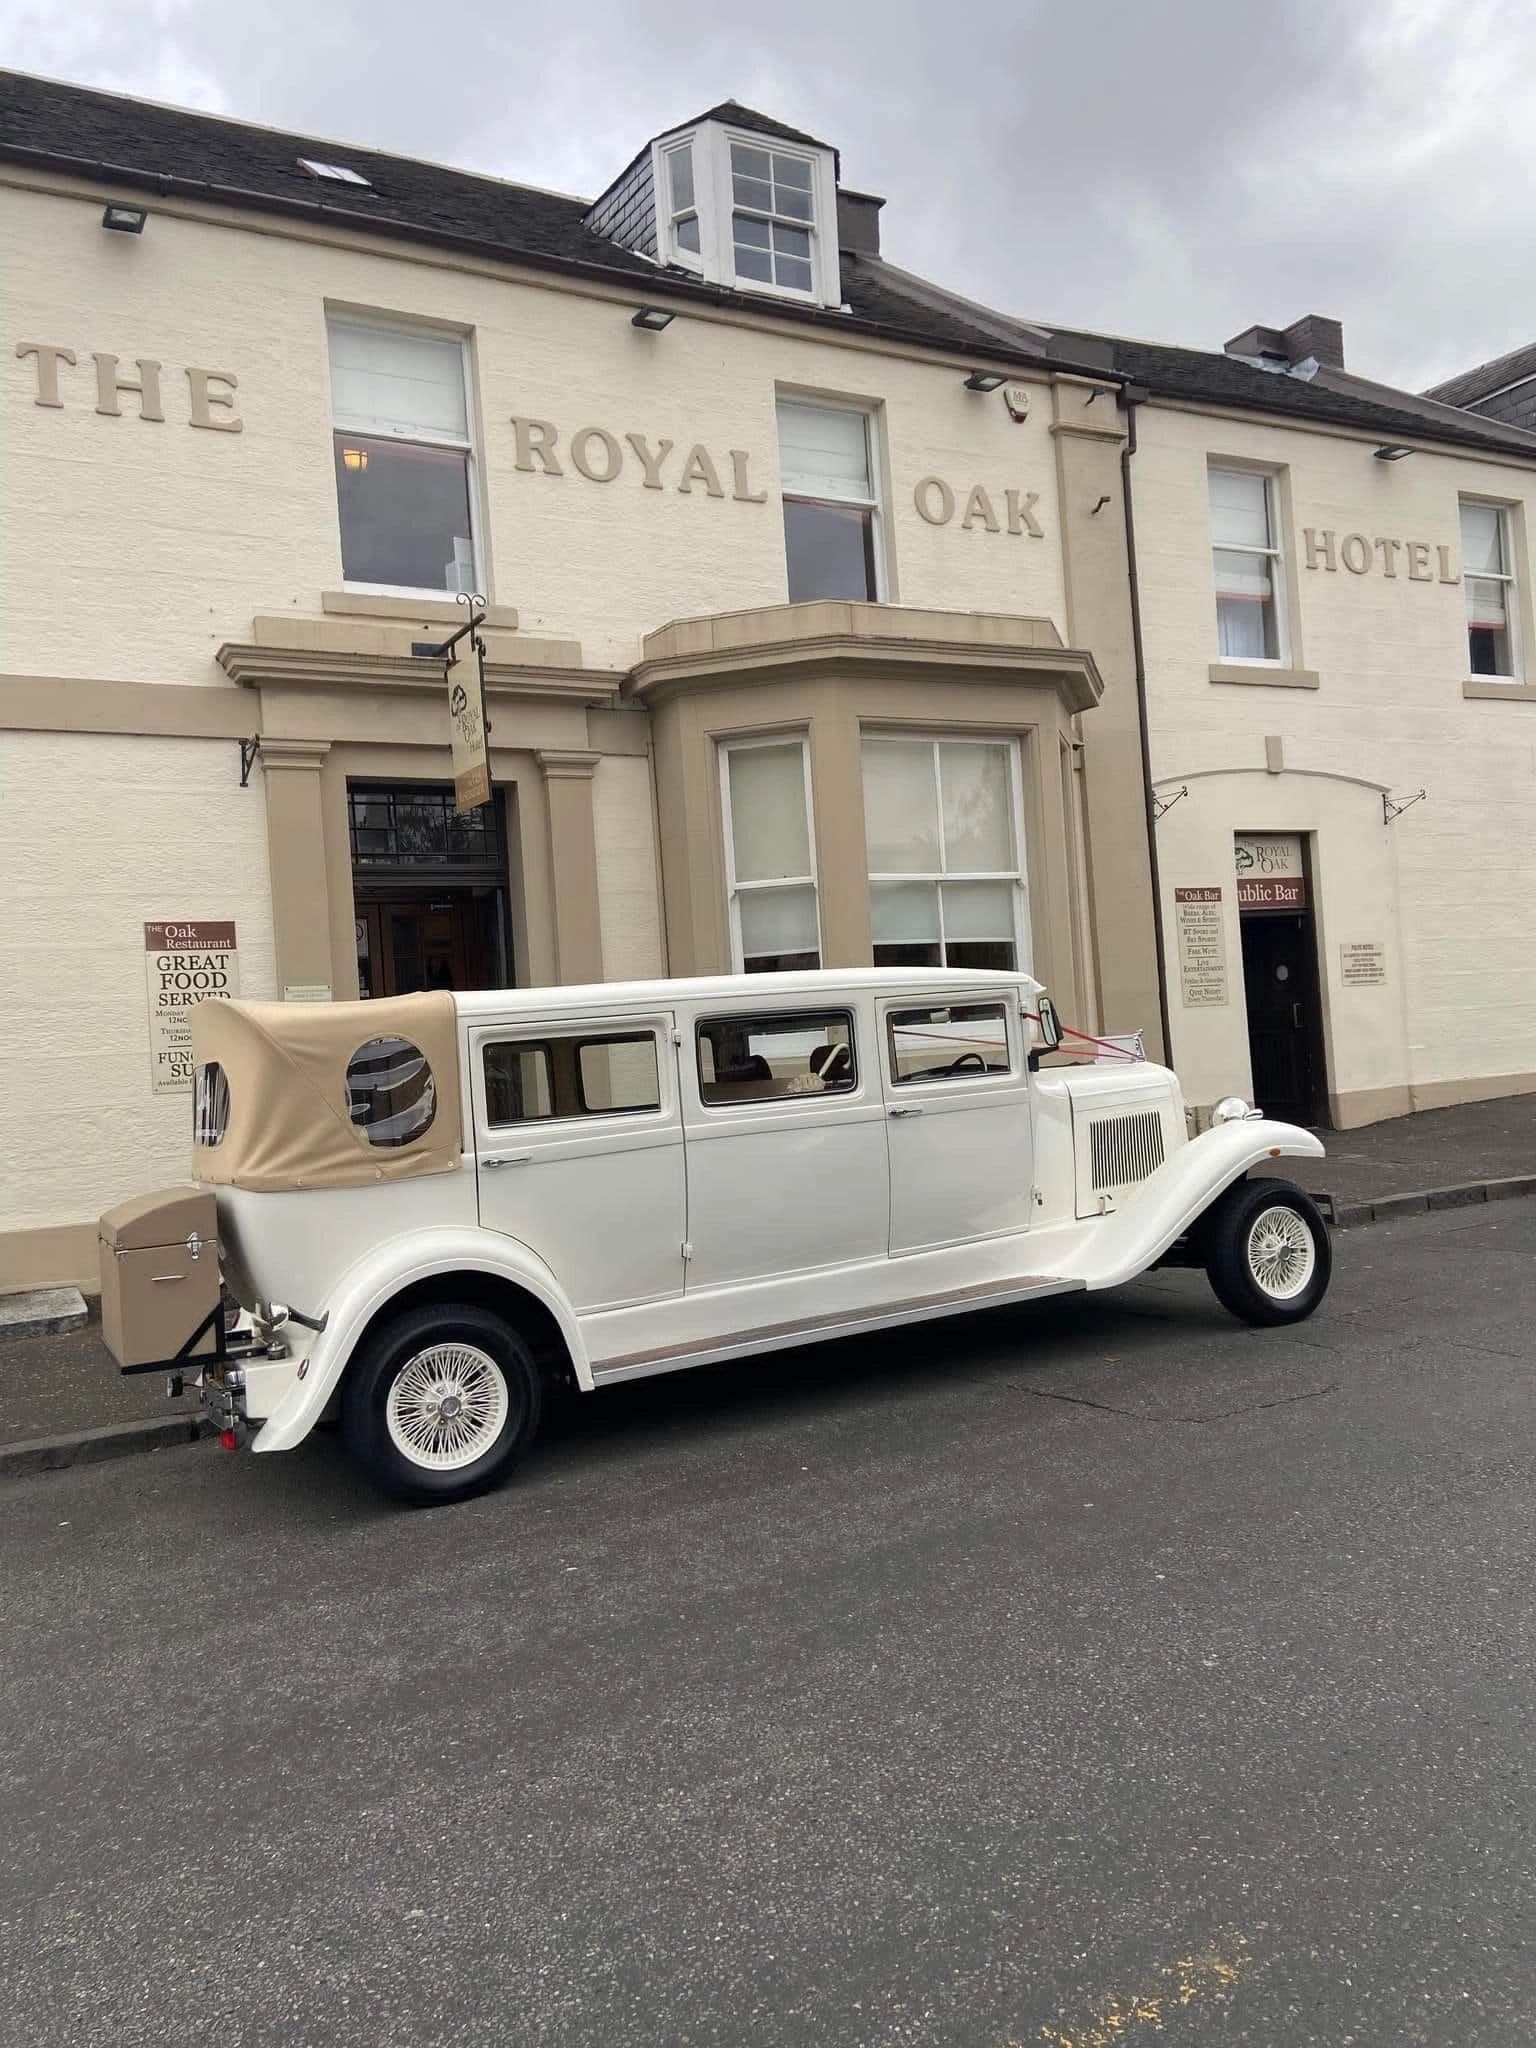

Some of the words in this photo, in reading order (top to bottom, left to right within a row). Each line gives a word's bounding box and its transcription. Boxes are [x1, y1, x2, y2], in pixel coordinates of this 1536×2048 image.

[15, 342, 243, 433] THE
[510, 415, 768, 504] ROYAL
[914, 476, 1045, 538] OAK
[1303, 527, 1460, 584] HOTEL
[1256, 846, 1293, 861] ROYAL
[1261, 857, 1289, 873] OAK
[1185, 890, 1203, 900] Oak
[1204, 890, 1219, 900] Bar
[1239, 884, 1272, 901] ublic
[1273, 884, 1299, 900] Bar
[146, 925, 163, 933] THE
[165, 925, 198, 938] Oak
[166, 939, 231, 950] Restaurant
[156, 954, 229, 971] GREAT
[160, 971, 228, 990] FOOD
[158, 1051, 194, 1064] FUN
